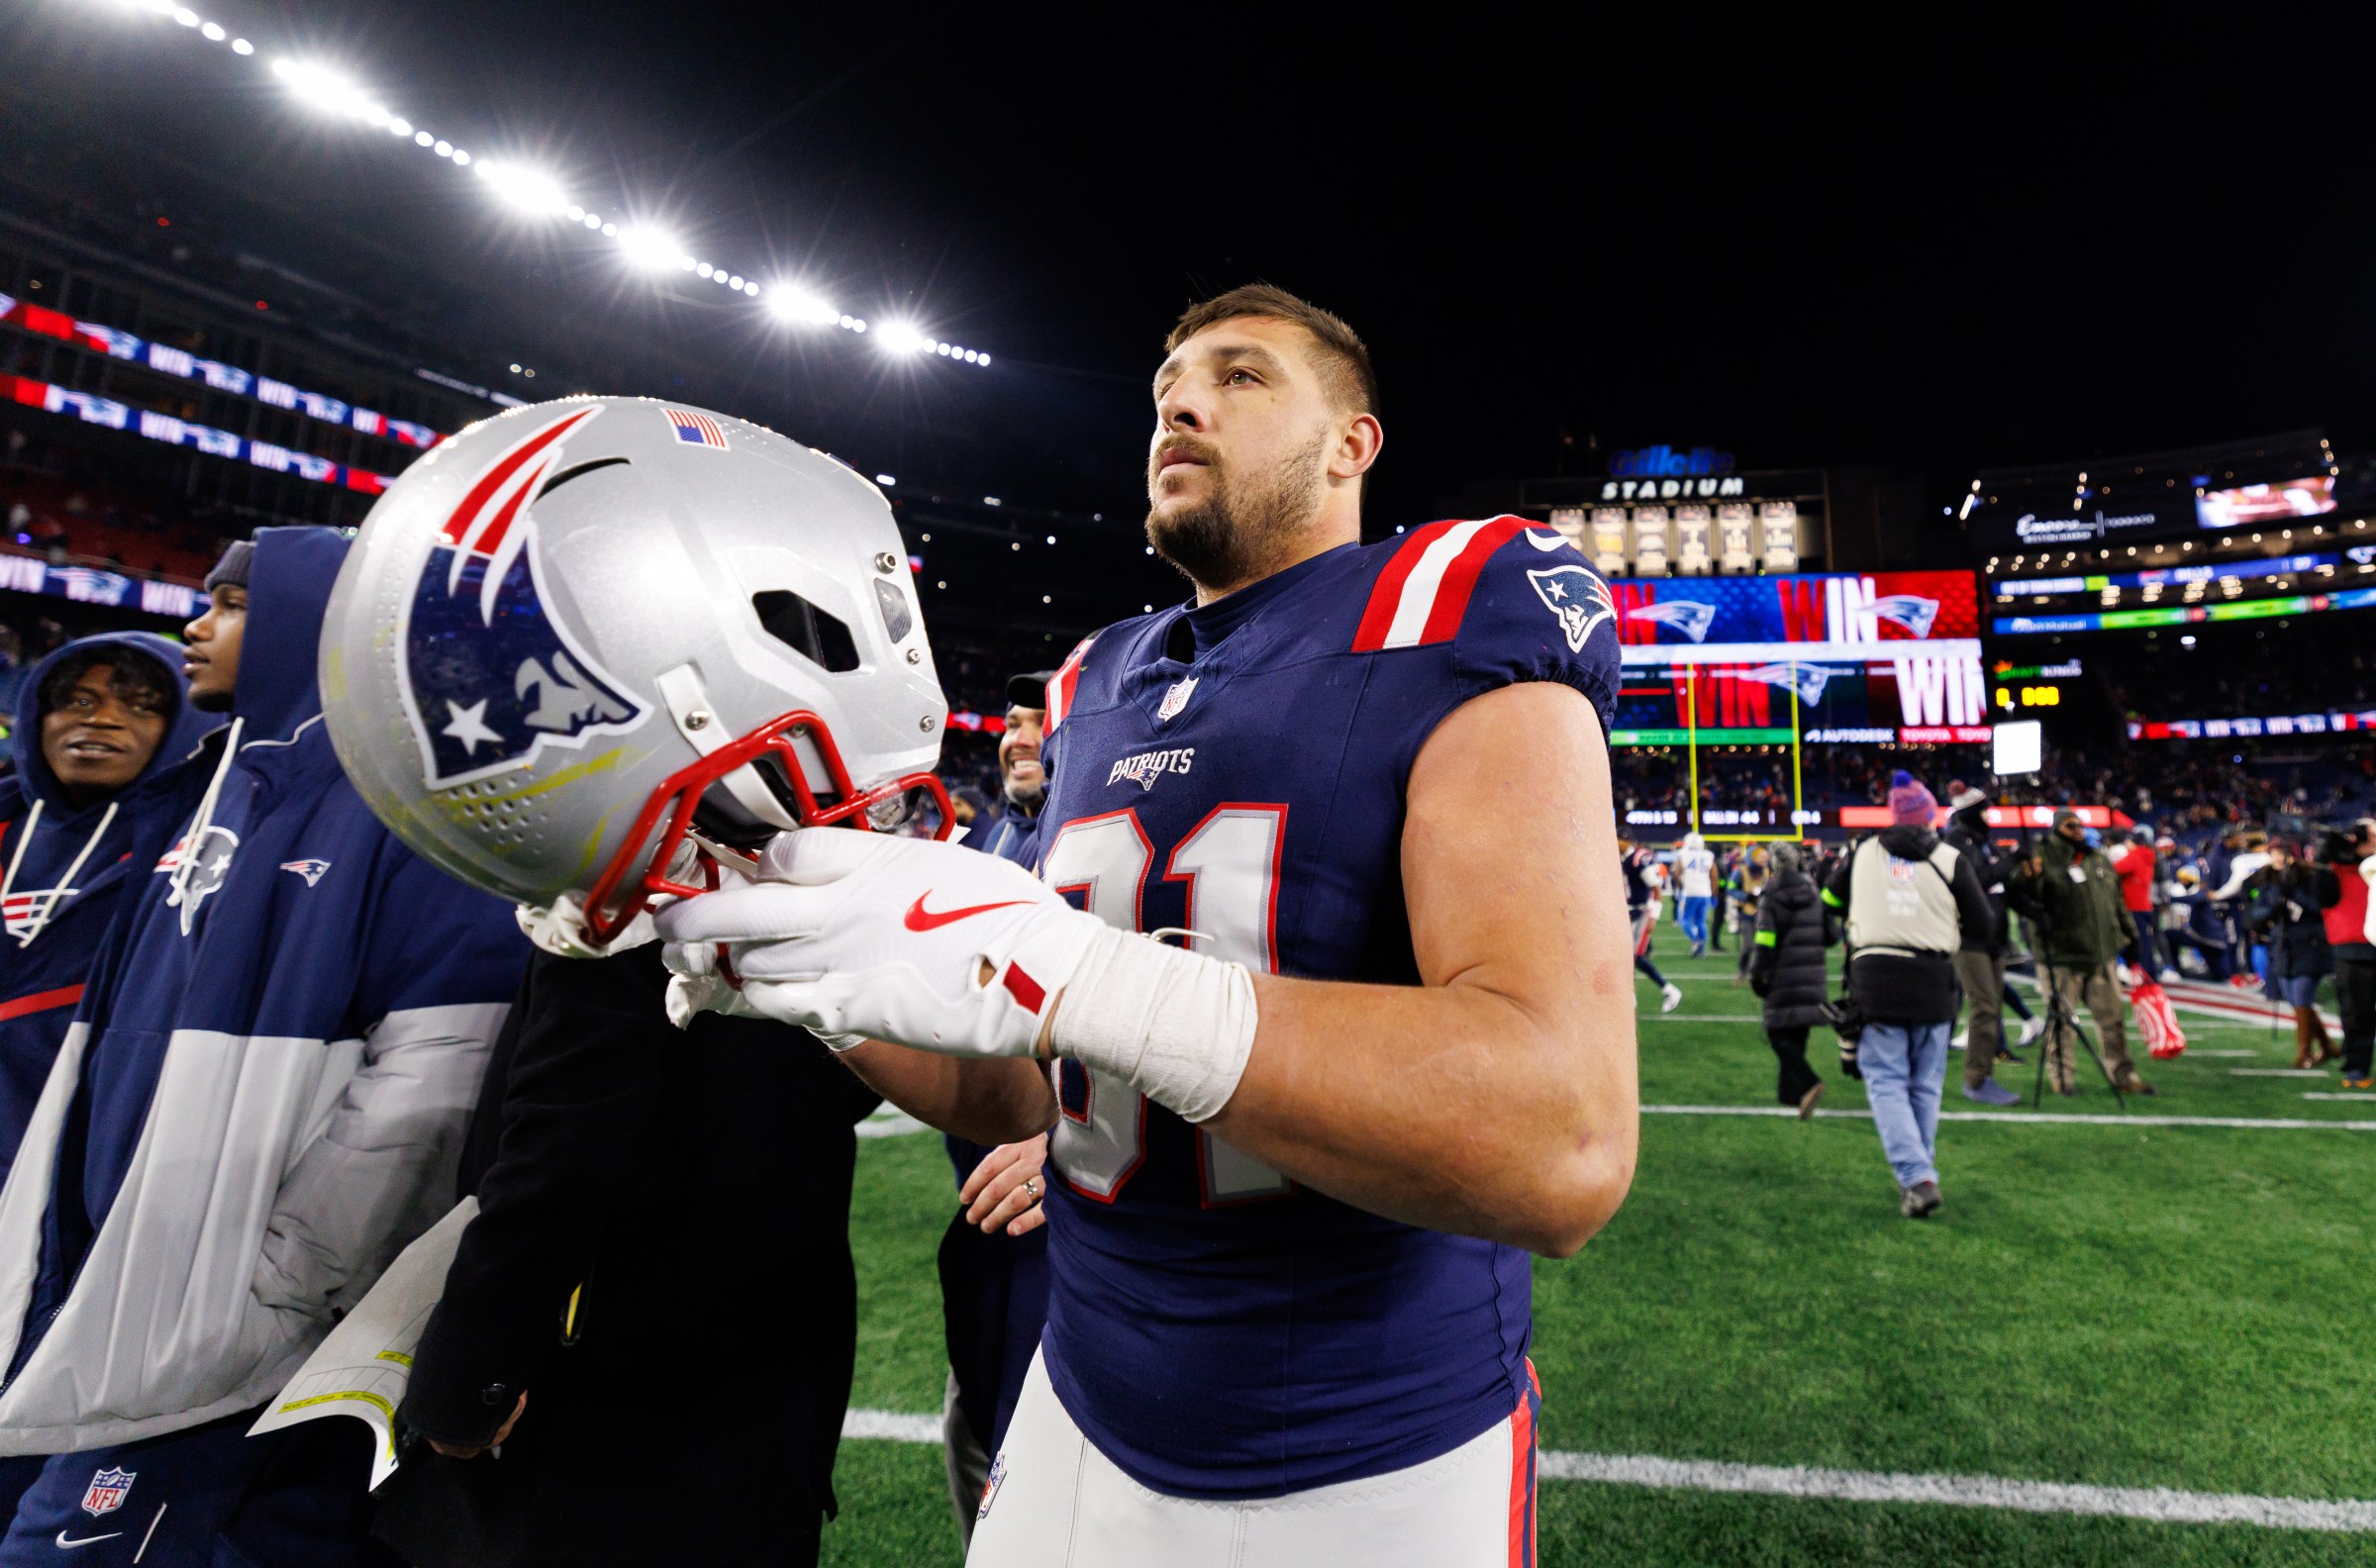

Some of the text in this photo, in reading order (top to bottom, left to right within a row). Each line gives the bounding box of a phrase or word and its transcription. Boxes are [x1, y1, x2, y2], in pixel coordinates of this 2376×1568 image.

[1601, 476, 1743, 501] STADIUM
[1776, 576, 1879, 643] WIN
[1163, 694, 1186, 713] NFL
[1822, 728, 1895, 742] AUTODESK
[1902, 729, 1952, 741] TOYOTA
[1106, 747, 1195, 786] PATRIOTS
[86, 1487, 121, 1511] NFL
